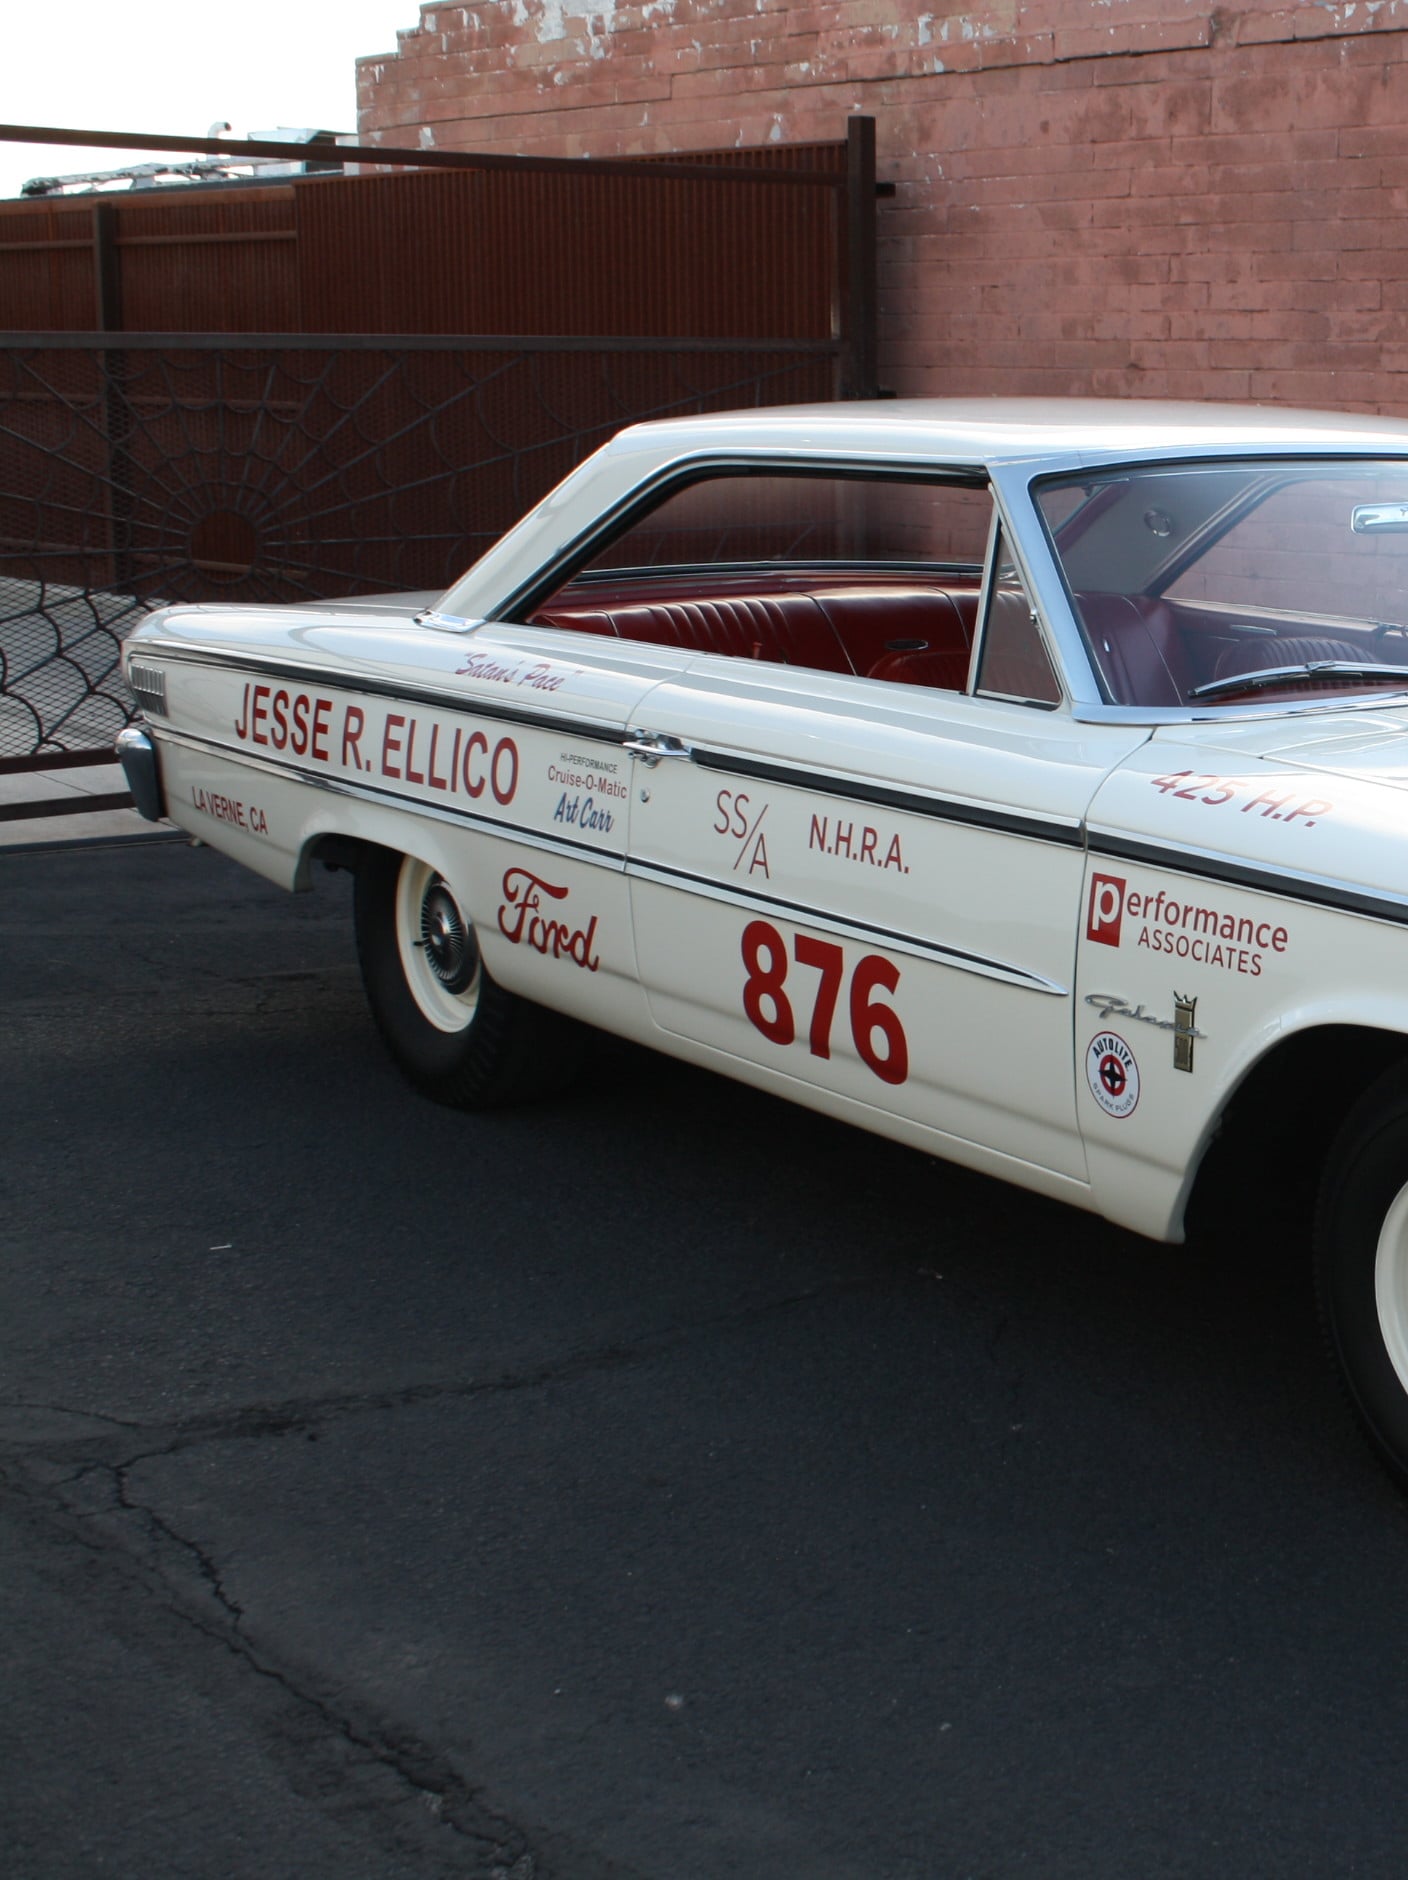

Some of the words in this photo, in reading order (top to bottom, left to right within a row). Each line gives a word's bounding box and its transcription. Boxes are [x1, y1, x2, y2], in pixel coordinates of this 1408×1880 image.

[234, 682, 333, 761] JESSE
[341, 704, 372, 773] R.
[381, 713, 519, 806] ELLICO
[560, 752, 618, 774] HI-PERFORMANCE
[548, 765, 628, 799] Cruise-O-Matic
[1151, 770, 1249, 805] 425
[1240, 788, 1334, 828] H.P.
[249, 806, 269, 835] CA
[553, 792, 580, 824] Art
[579, 797, 615, 833] Carr
[808, 814, 910, 874] N.H.R.A.
[498, 867, 599, 972] Ford
[1137, 925, 1263, 977] ASSOCIATES
[741, 919, 909, 1085] 876
[1093, 1038, 1133, 1069] AUTOLITE
[1093, 1082, 1114, 1110] SPARK
